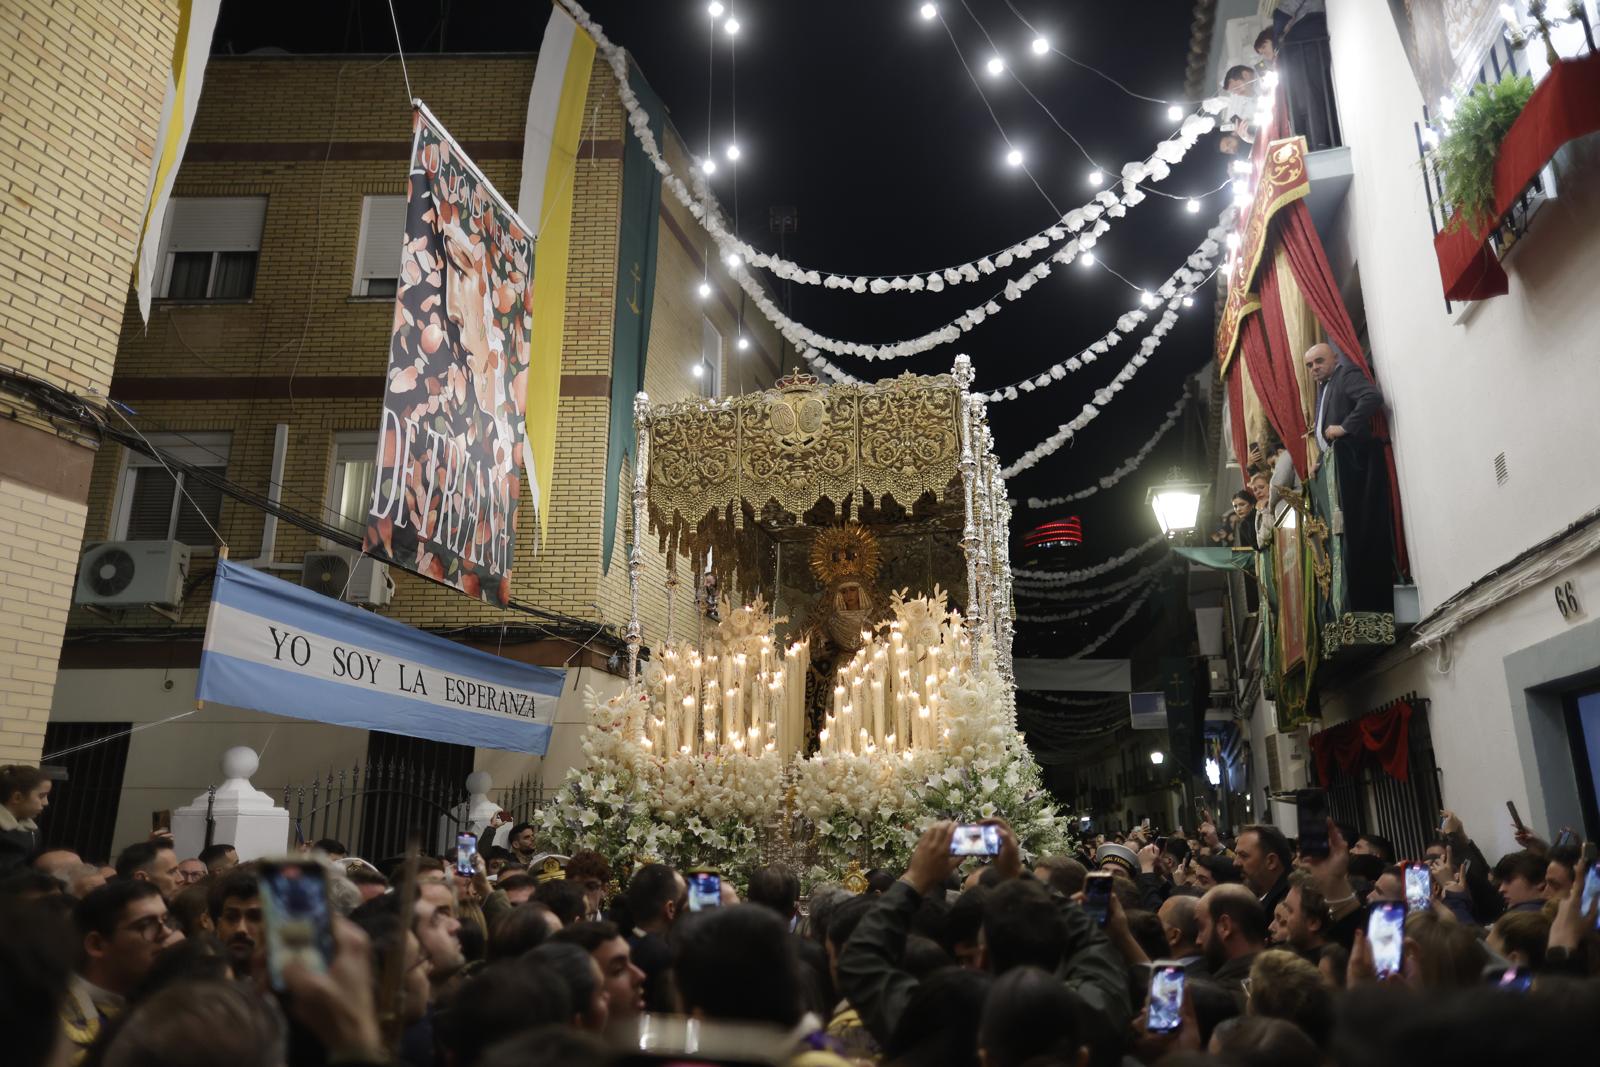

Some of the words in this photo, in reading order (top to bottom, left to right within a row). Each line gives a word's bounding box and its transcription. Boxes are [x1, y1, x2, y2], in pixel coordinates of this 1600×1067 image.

[1555, 581, 1578, 616] 66
[268, 626, 311, 666] YO
[332, 646, 381, 684] SOY
[399, 663, 428, 695] LA
[444, 676, 536, 718] ESPERANZA
